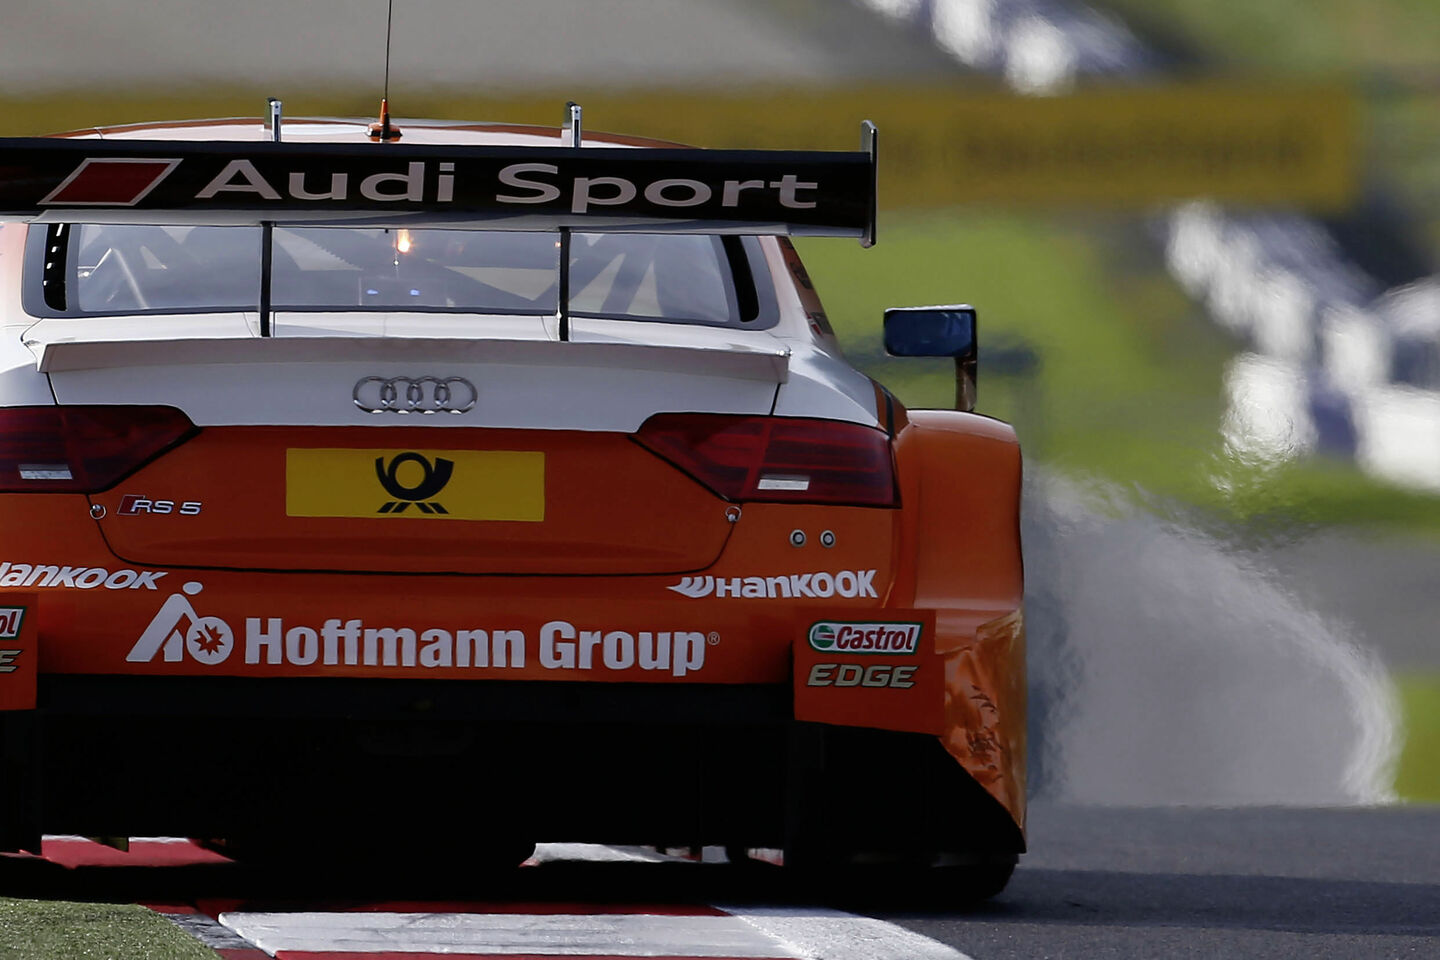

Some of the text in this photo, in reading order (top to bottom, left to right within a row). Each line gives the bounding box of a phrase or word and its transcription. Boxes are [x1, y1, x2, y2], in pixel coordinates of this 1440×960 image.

[194, 158, 818, 214] Audi Sport
[130, 498, 203, 516] RS 5
[245, 617, 525, 669] Hoffmann
[835, 625, 914, 651] Castrol
[807, 663, 918, 689] EDGE
